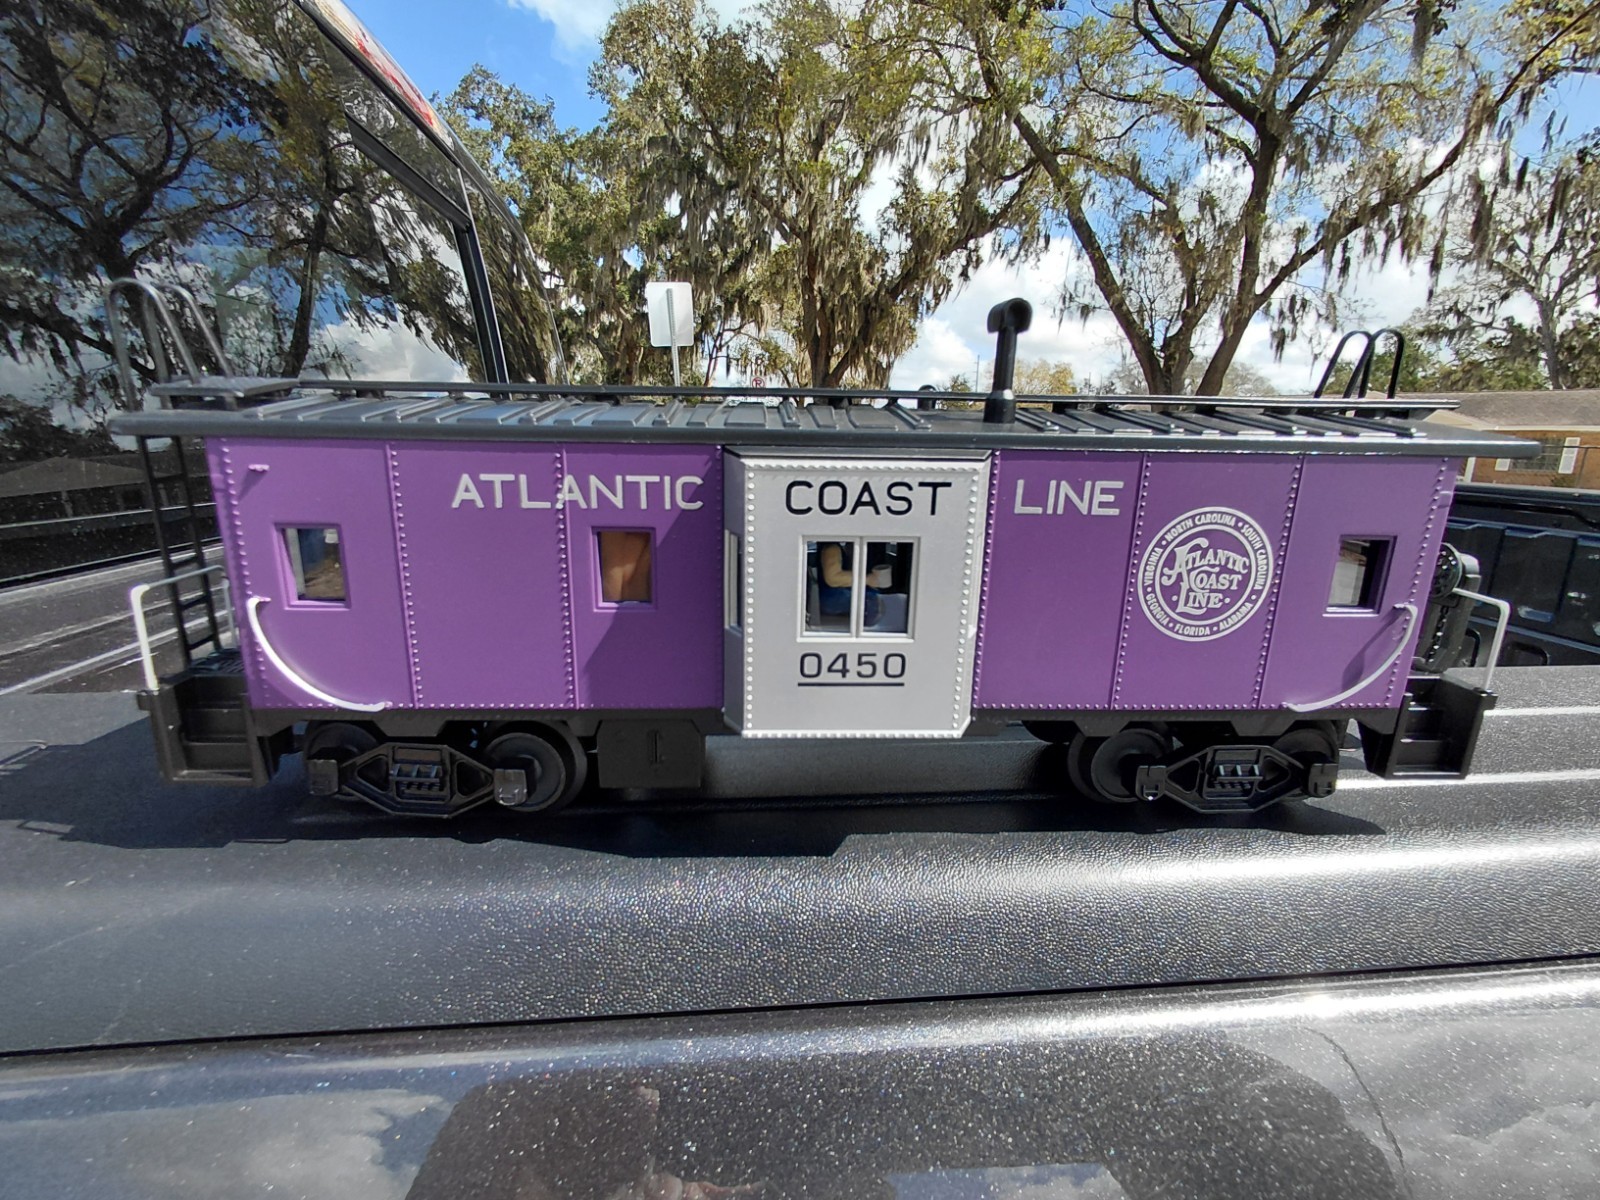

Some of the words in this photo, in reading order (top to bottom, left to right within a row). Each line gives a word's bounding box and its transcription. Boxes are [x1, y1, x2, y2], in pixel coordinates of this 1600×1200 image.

[452, 473, 704, 510] ATLANTIC
[785, 480, 952, 516] COAST
[1014, 479, 1125, 516] LINE
[1164, 519, 1194, 542] NORTH
[1194, 513, 1236, 527] CAROLINA
[1143, 547, 1163, 586] VIRGINIA
[1161, 537, 1250, 586] ATLANTIC
[1240, 524, 1262, 551] SOUTH
[1253, 548, 1268, 590] CAROLINA
[1189, 566, 1242, 593] COAST
[1145, 593, 1170, 626] GEORGIA
[1175, 582, 1223, 616] LINE
[1173, 623, 1211, 636] FLORIDA
[1218, 602, 1254, 631] ALABAMA
[799, 652, 906, 679] 0450
